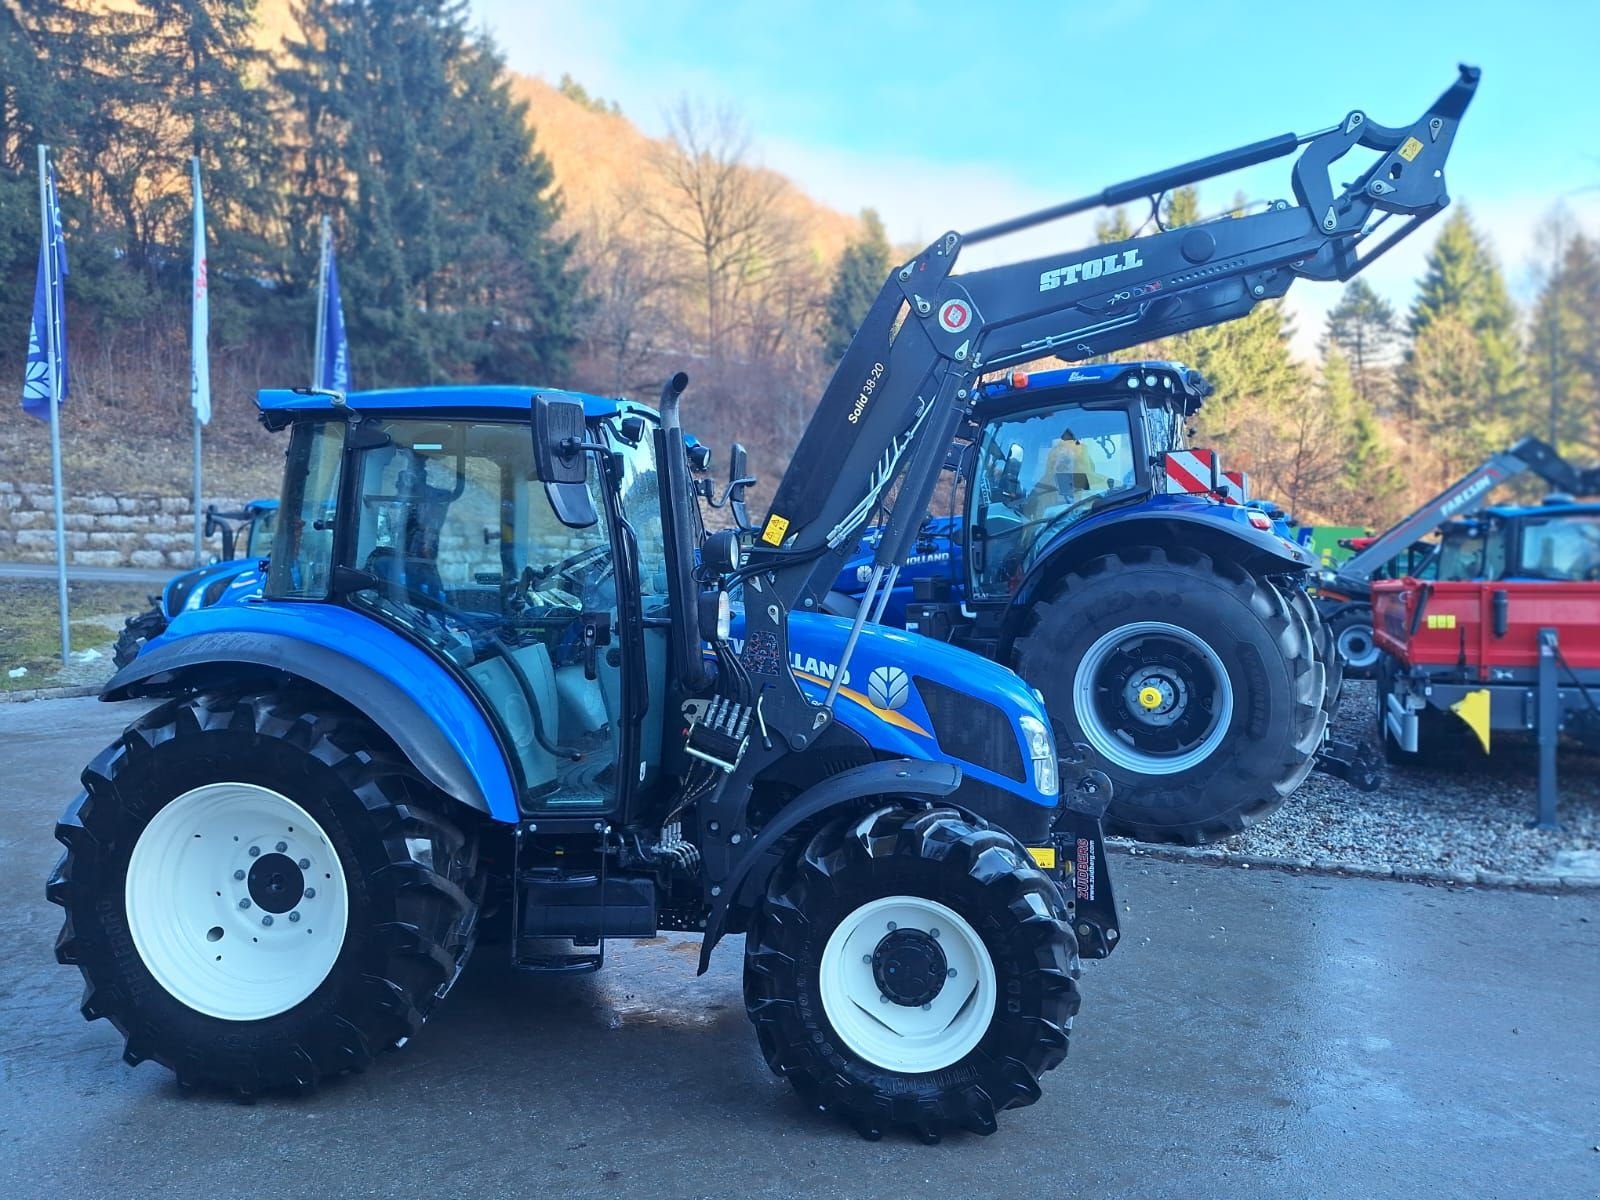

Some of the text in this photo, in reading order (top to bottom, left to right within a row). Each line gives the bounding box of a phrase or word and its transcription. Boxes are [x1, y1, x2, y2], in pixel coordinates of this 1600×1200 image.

[1039, 249, 1143, 292] STOLL
[848, 362, 884, 424] Solid 38-20
[1076, 838, 1089, 900] ZUIDBERG
